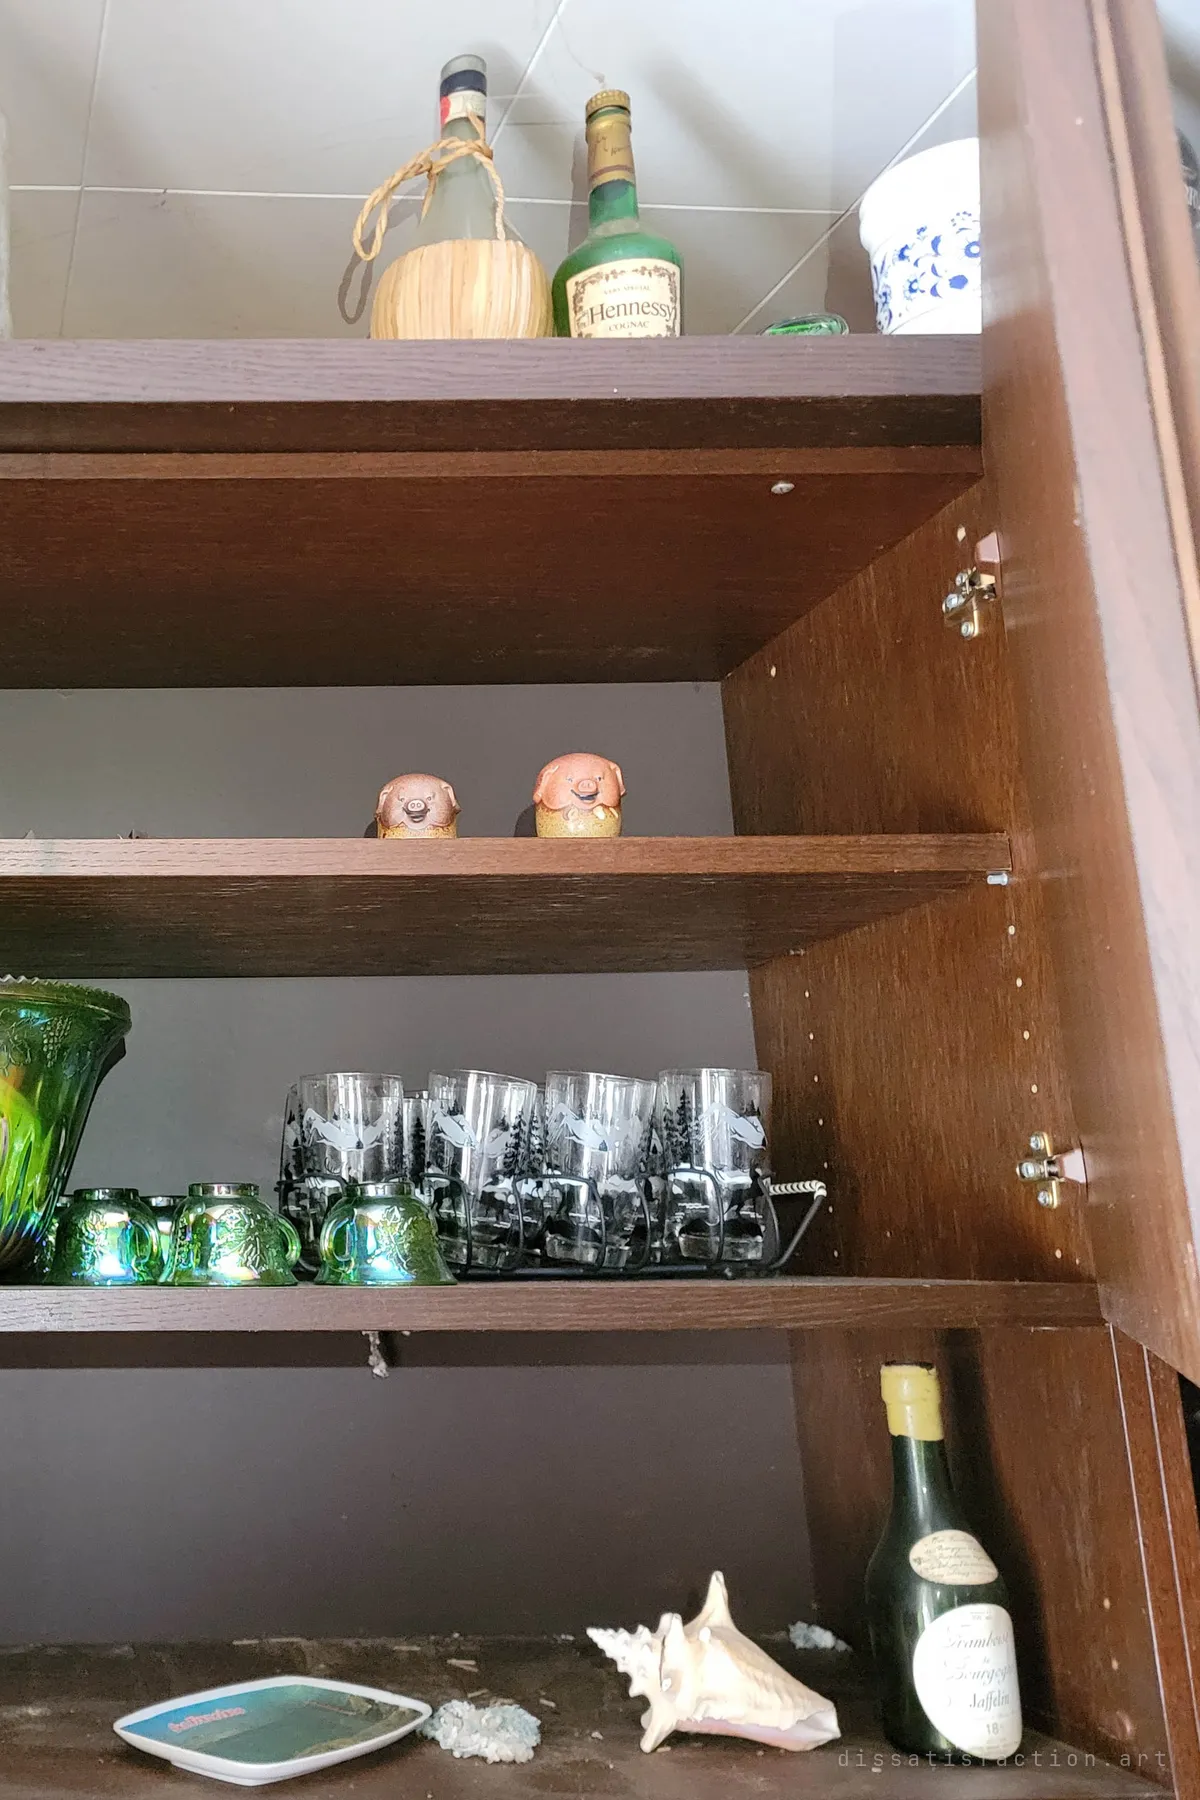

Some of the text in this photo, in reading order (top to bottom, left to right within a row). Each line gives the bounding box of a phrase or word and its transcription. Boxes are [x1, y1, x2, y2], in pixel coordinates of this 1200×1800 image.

[589, 301, 676, 325] Hennessy
[609, 320, 650, 332] COGNAC
[969, 1690, 1010, 1712] Jaffelin
